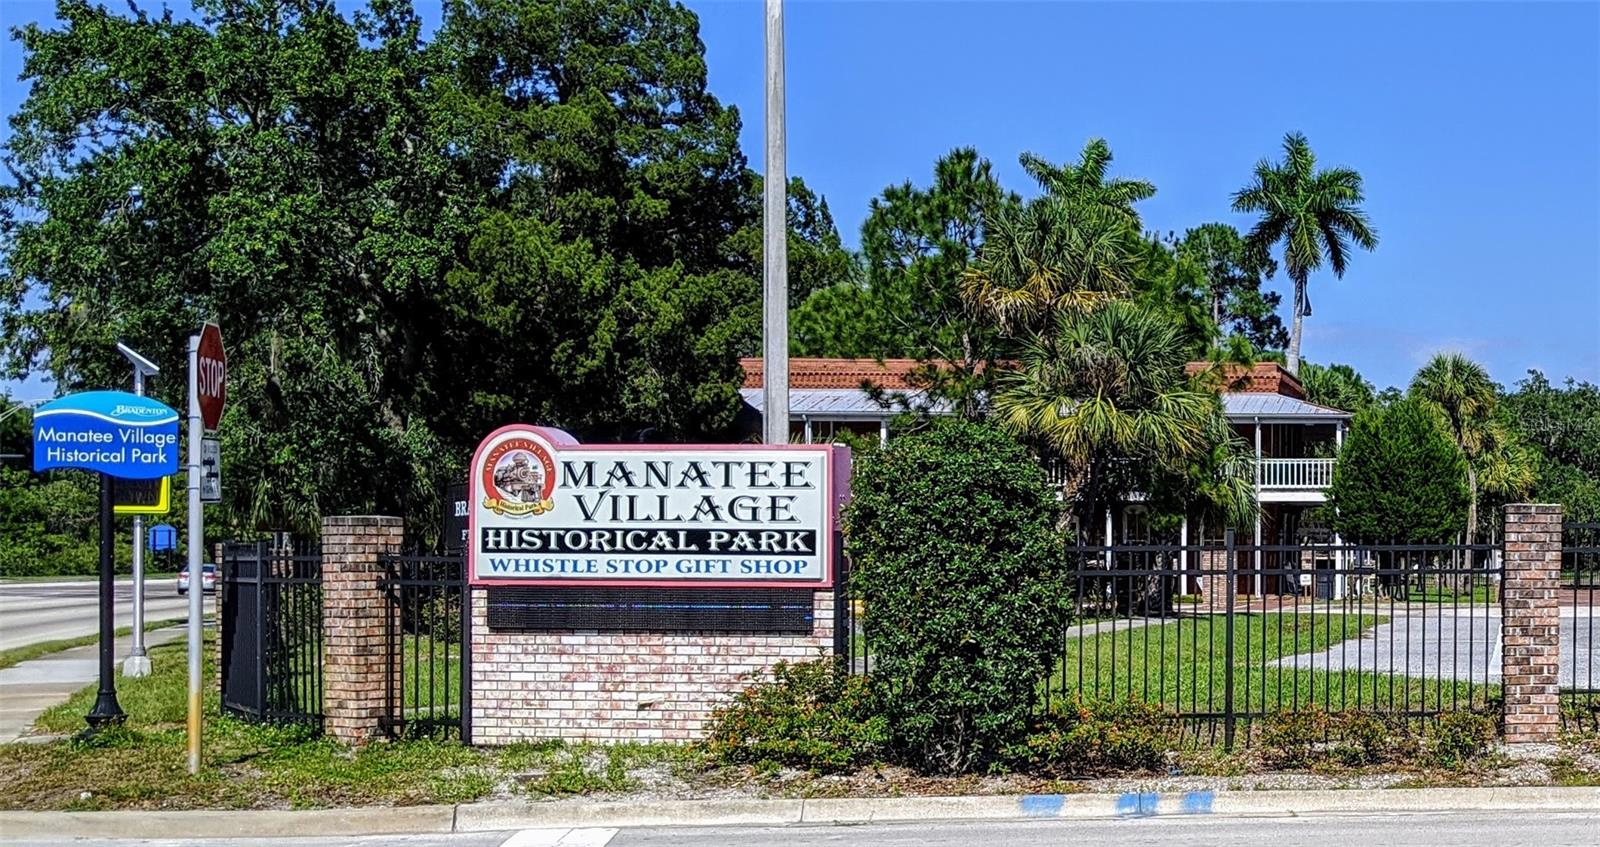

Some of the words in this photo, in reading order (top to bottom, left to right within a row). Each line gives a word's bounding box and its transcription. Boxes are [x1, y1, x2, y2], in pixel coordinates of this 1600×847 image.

[199, 356, 224, 398] STOP
[38, 427, 113, 443] Manatee
[119, 428, 176, 448] Village
[47, 447, 125, 463] Historical
[132, 448, 167, 463] Park
[559, 460, 815, 490] MANATEE
[572, 488, 801, 523] VILLAGE
[485, 529, 698, 552] HISTORICAL
[708, 530, 812, 553] PARK
[490, 558, 598, 574] WHISTLE
[606, 559, 668, 574] STOP
[676, 559, 732, 574] GIFT
[740, 560, 808, 575] SHOP
